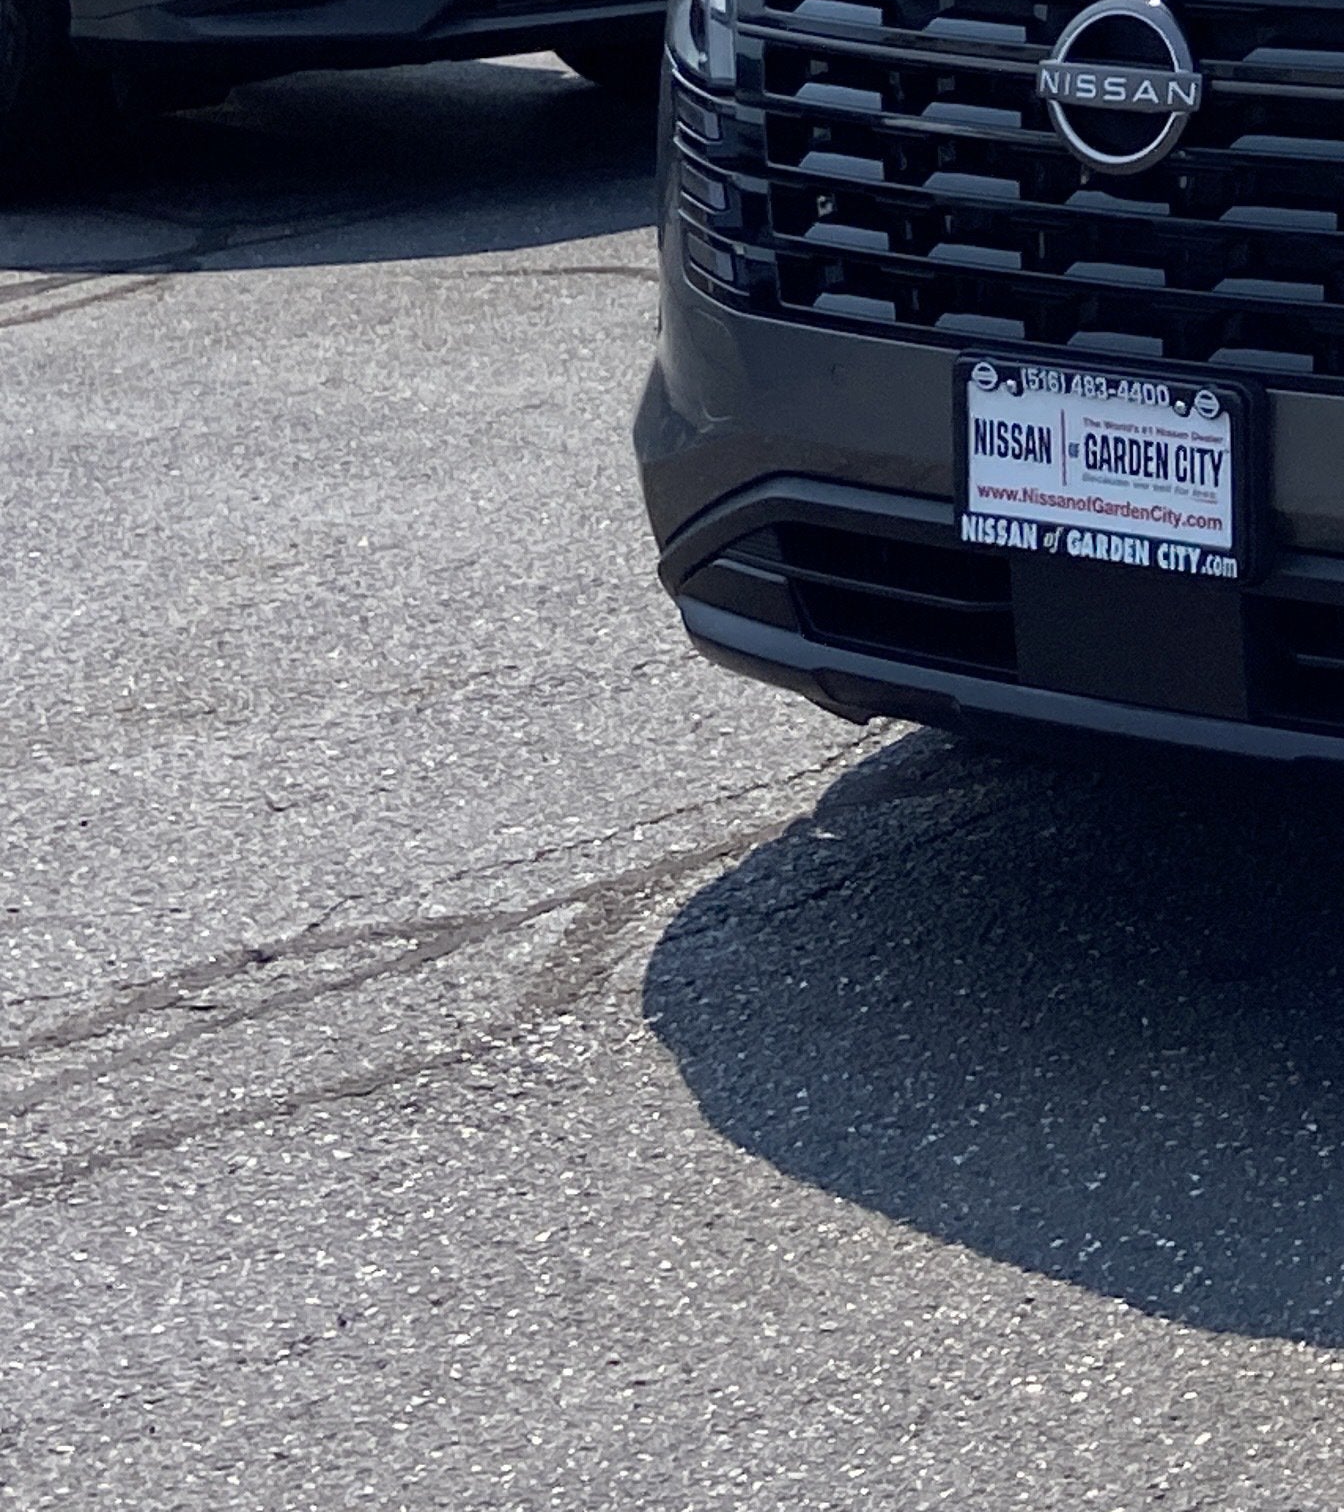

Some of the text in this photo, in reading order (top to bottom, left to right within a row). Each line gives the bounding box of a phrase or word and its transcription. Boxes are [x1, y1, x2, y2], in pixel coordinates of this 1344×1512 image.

[1039, 68, 1197, 106] NISSAN
[1020, 367, 1170, 407] (516) 483-4400
[973, 417, 1052, 465] NISSAN
[1084, 432, 1169, 480] GARDEN
[1175, 444, 1223, 488] CITY
[976, 482, 1223, 532] www.NissanofGardenCity.com
[960, 513, 1038, 550] NISSAN
[1043, 526, 1065, 554] of
[1066, 529, 1150, 567] GARDEN
